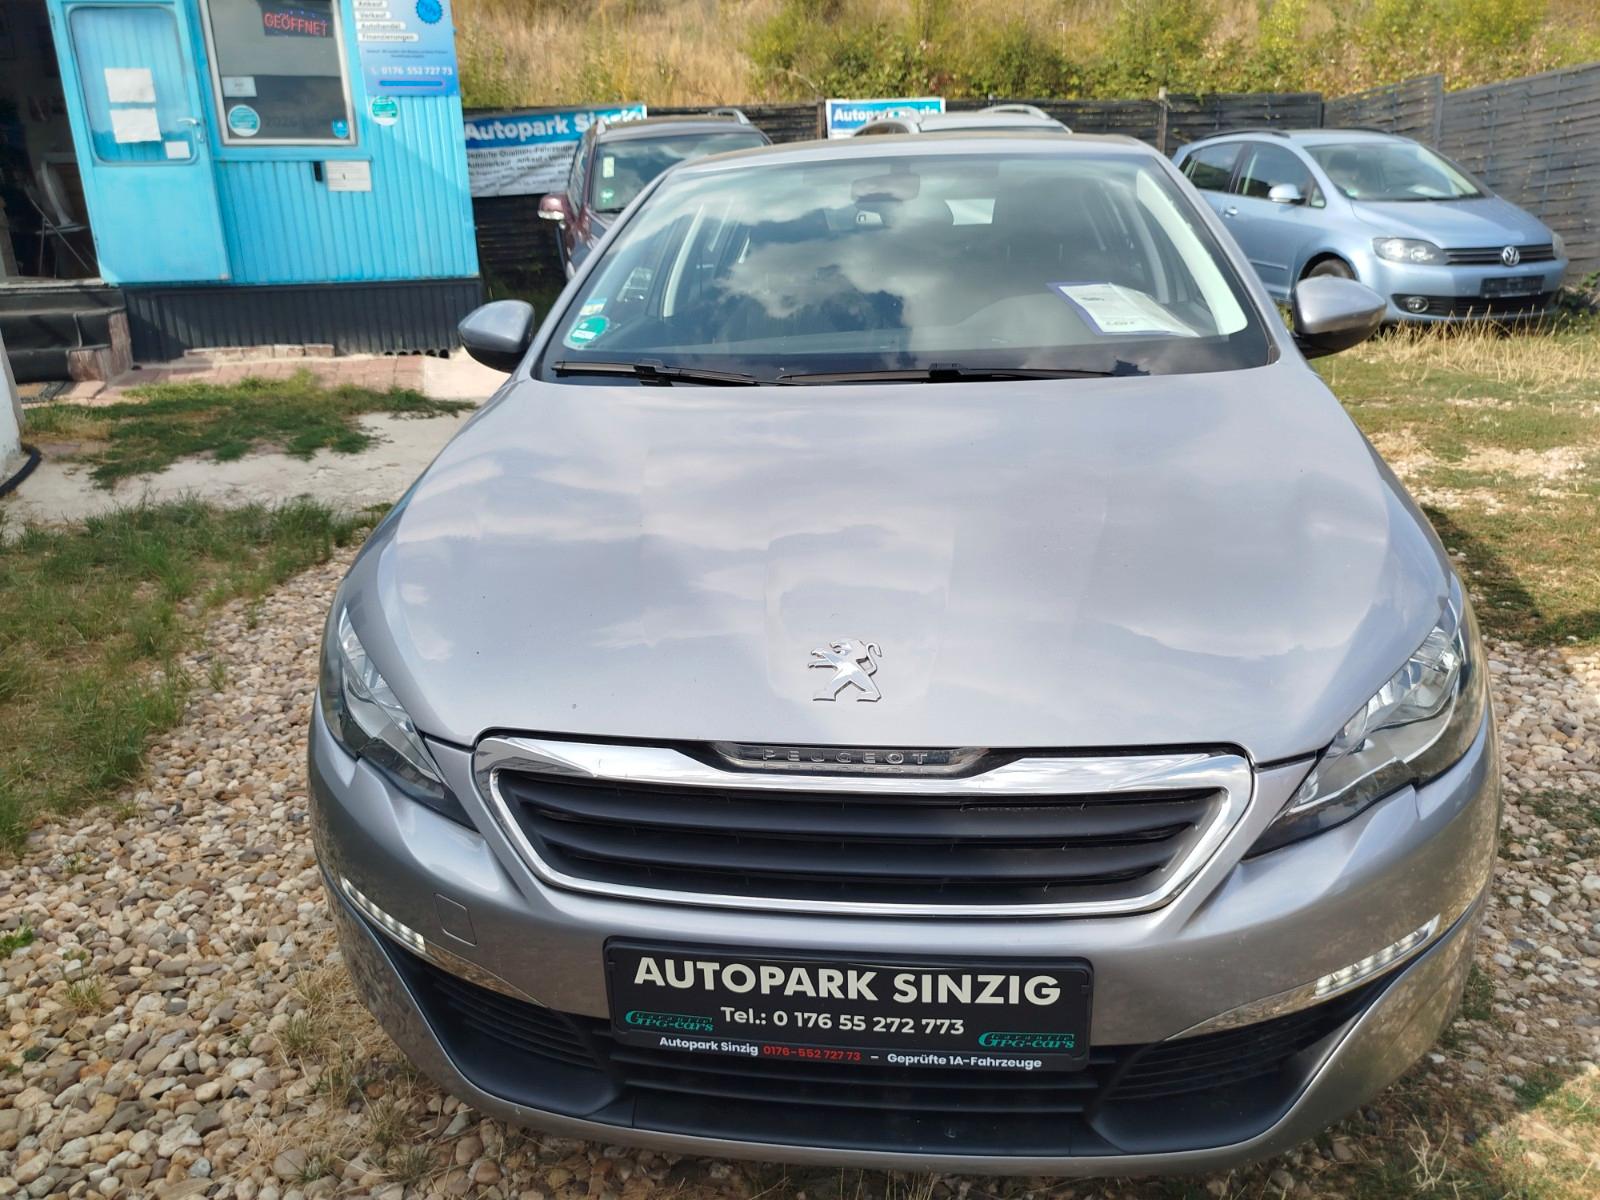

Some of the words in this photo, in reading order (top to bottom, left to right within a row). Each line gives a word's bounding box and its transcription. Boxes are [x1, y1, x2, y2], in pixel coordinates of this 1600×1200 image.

[264, 13, 328, 36] GEÖFFNET
[465, 116, 569, 142] Autopark
[762, 749, 928, 765] PEUGEOT
[634, 957, 879, 1001] AUTOPARK
[893, 973, 1061, 1006] SINZIG
[720, 1007, 767, 1025] Tel.:
[773, 1010, 788, 1026] 0
[794, 1012, 832, 1029] 176
[839, 1015, 867, 1031] 55
[873, 1017, 915, 1034] 272
[921, 1019, 965, 1035] 773
[660, 1037, 718, 1052] Autopark
[721, 1042, 759, 1057] Sinzig
[887, 1053, 947, 1066] Geprüfte
[950, 1056, 1042, 1071] 1A-Fahrzeuge
